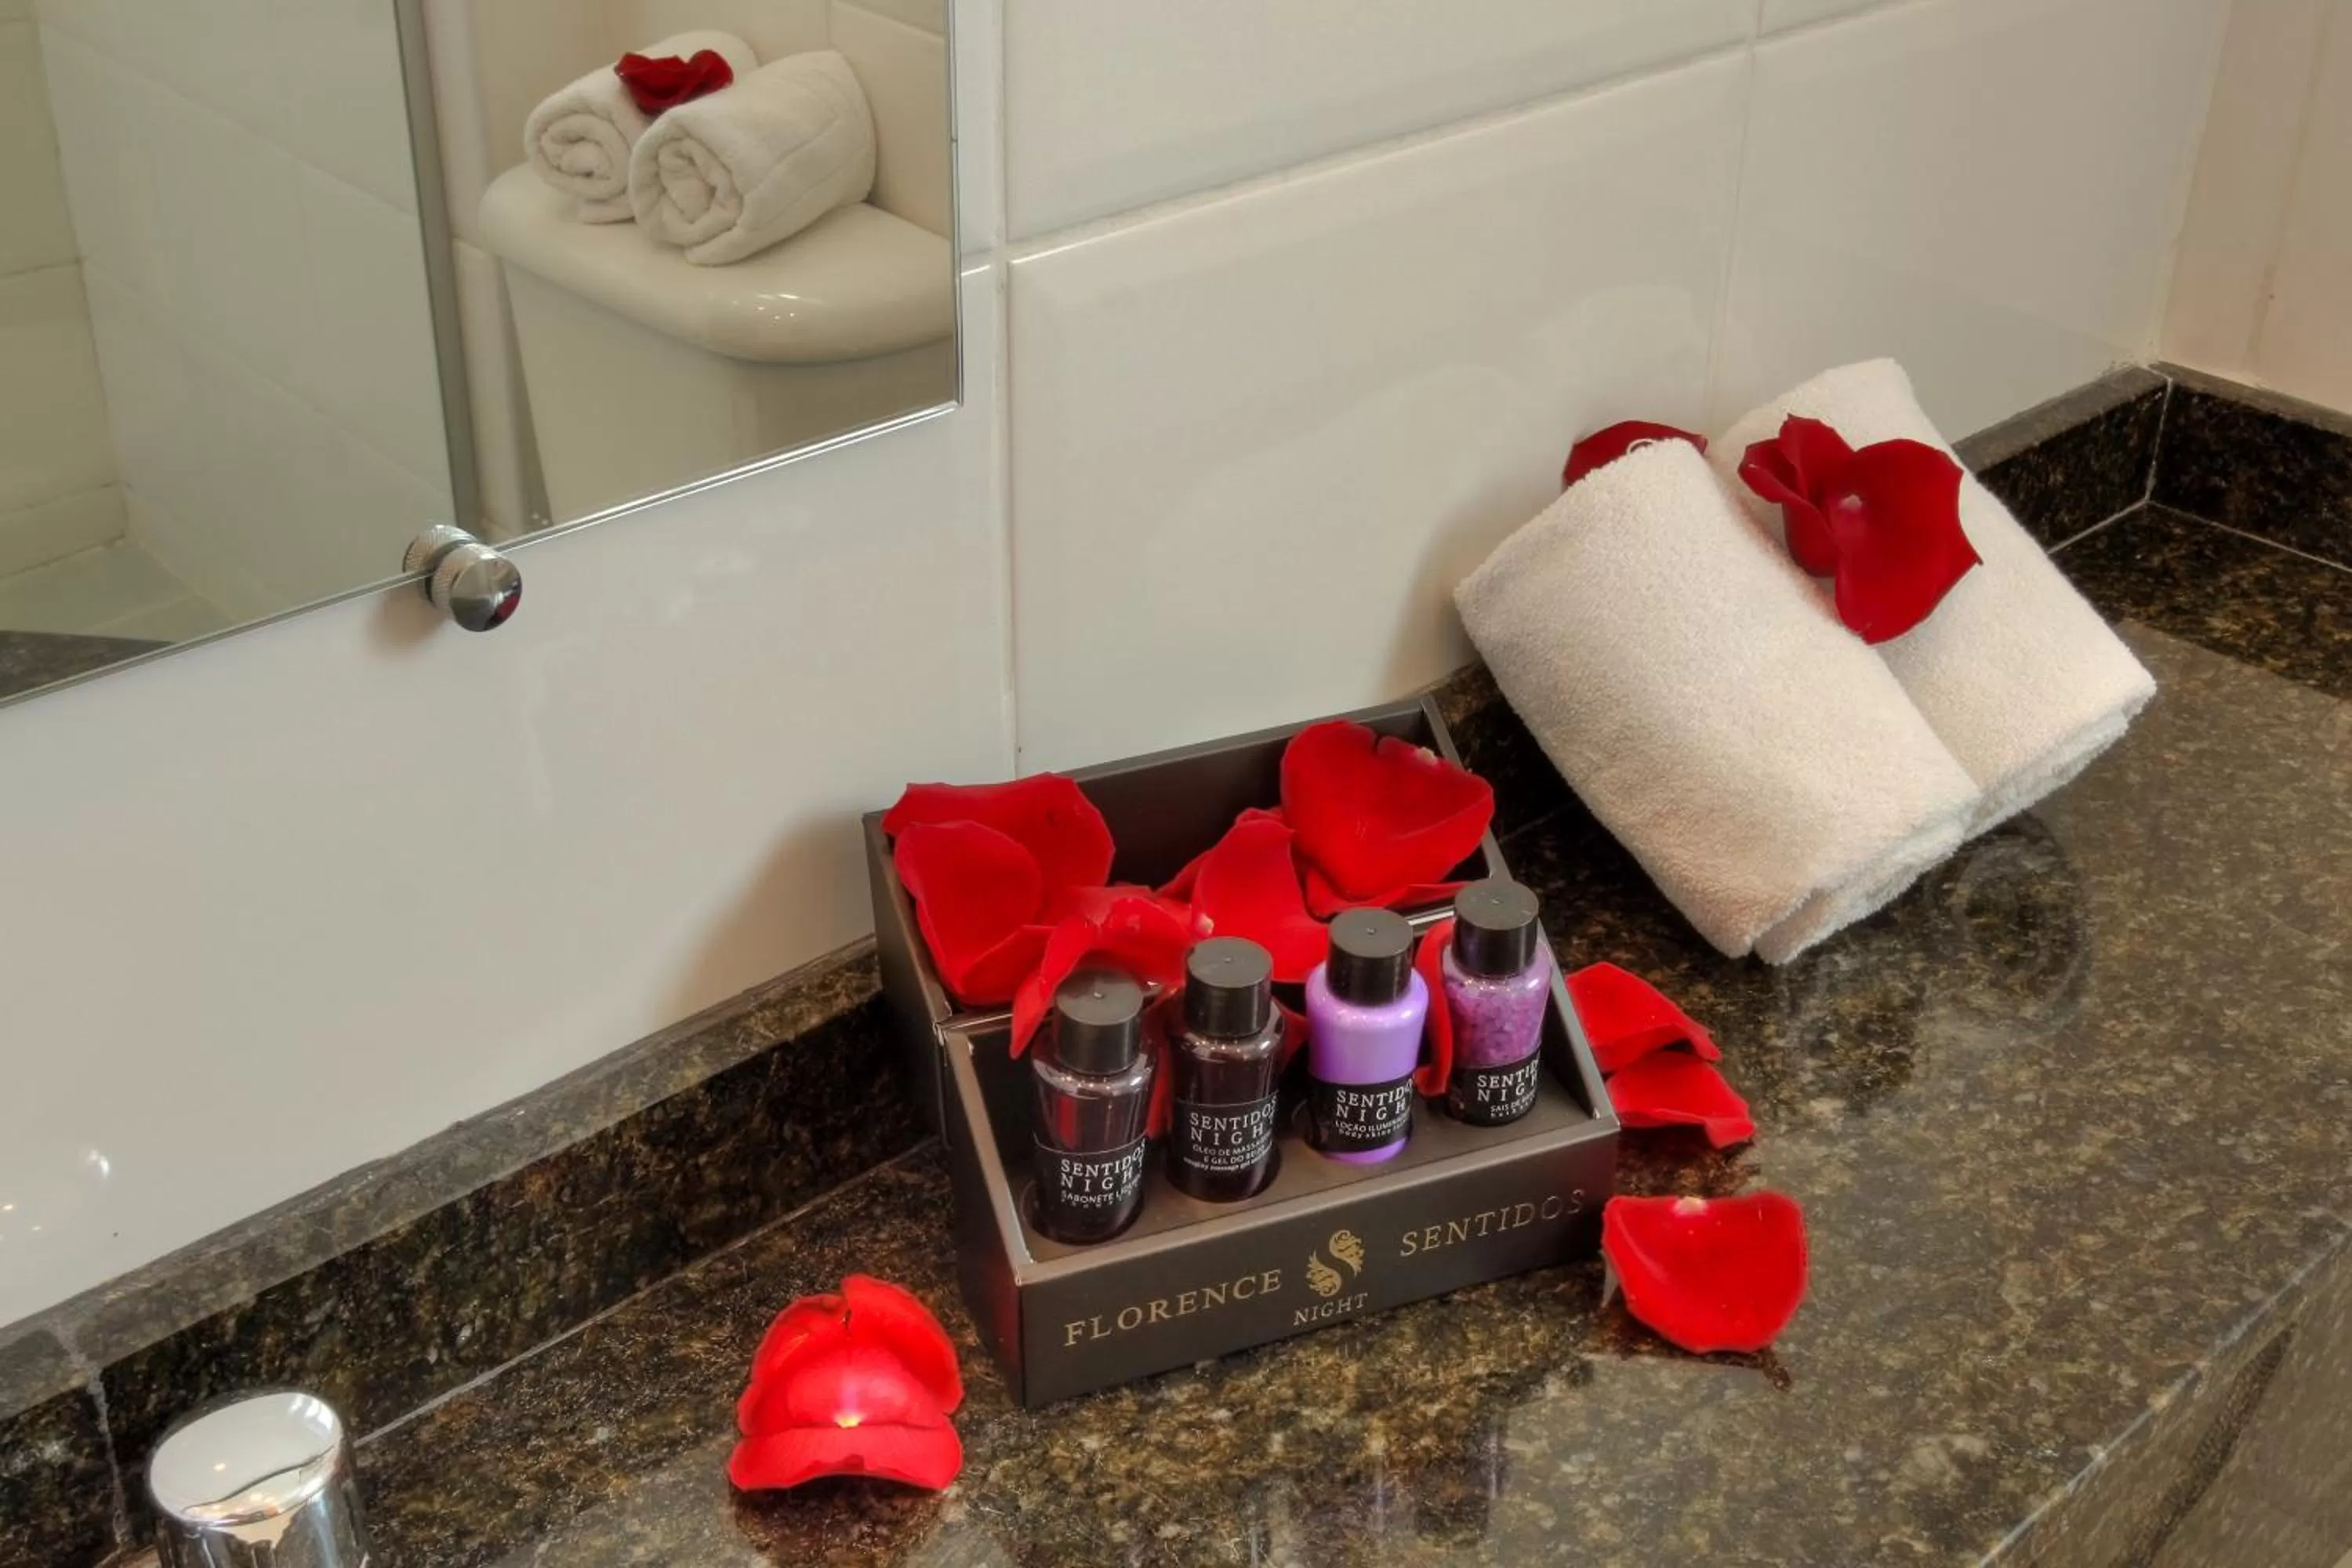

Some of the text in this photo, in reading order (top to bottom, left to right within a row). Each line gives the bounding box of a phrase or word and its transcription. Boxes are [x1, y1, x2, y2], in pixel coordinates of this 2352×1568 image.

[1336, 1078, 1412, 1108] SENTIDO
[1336, 1096, 1408, 1122] NIGH
[1061, 1156, 1142, 1192] NIGH
[1230, 1155, 1244, 1164] DO
[1061, 1189, 1114, 1203] SABONETE
[1063, 1189, 1584, 1347] FLORENCE SENTIDOS
[1293, 1292, 1368, 1327] NIGHT
